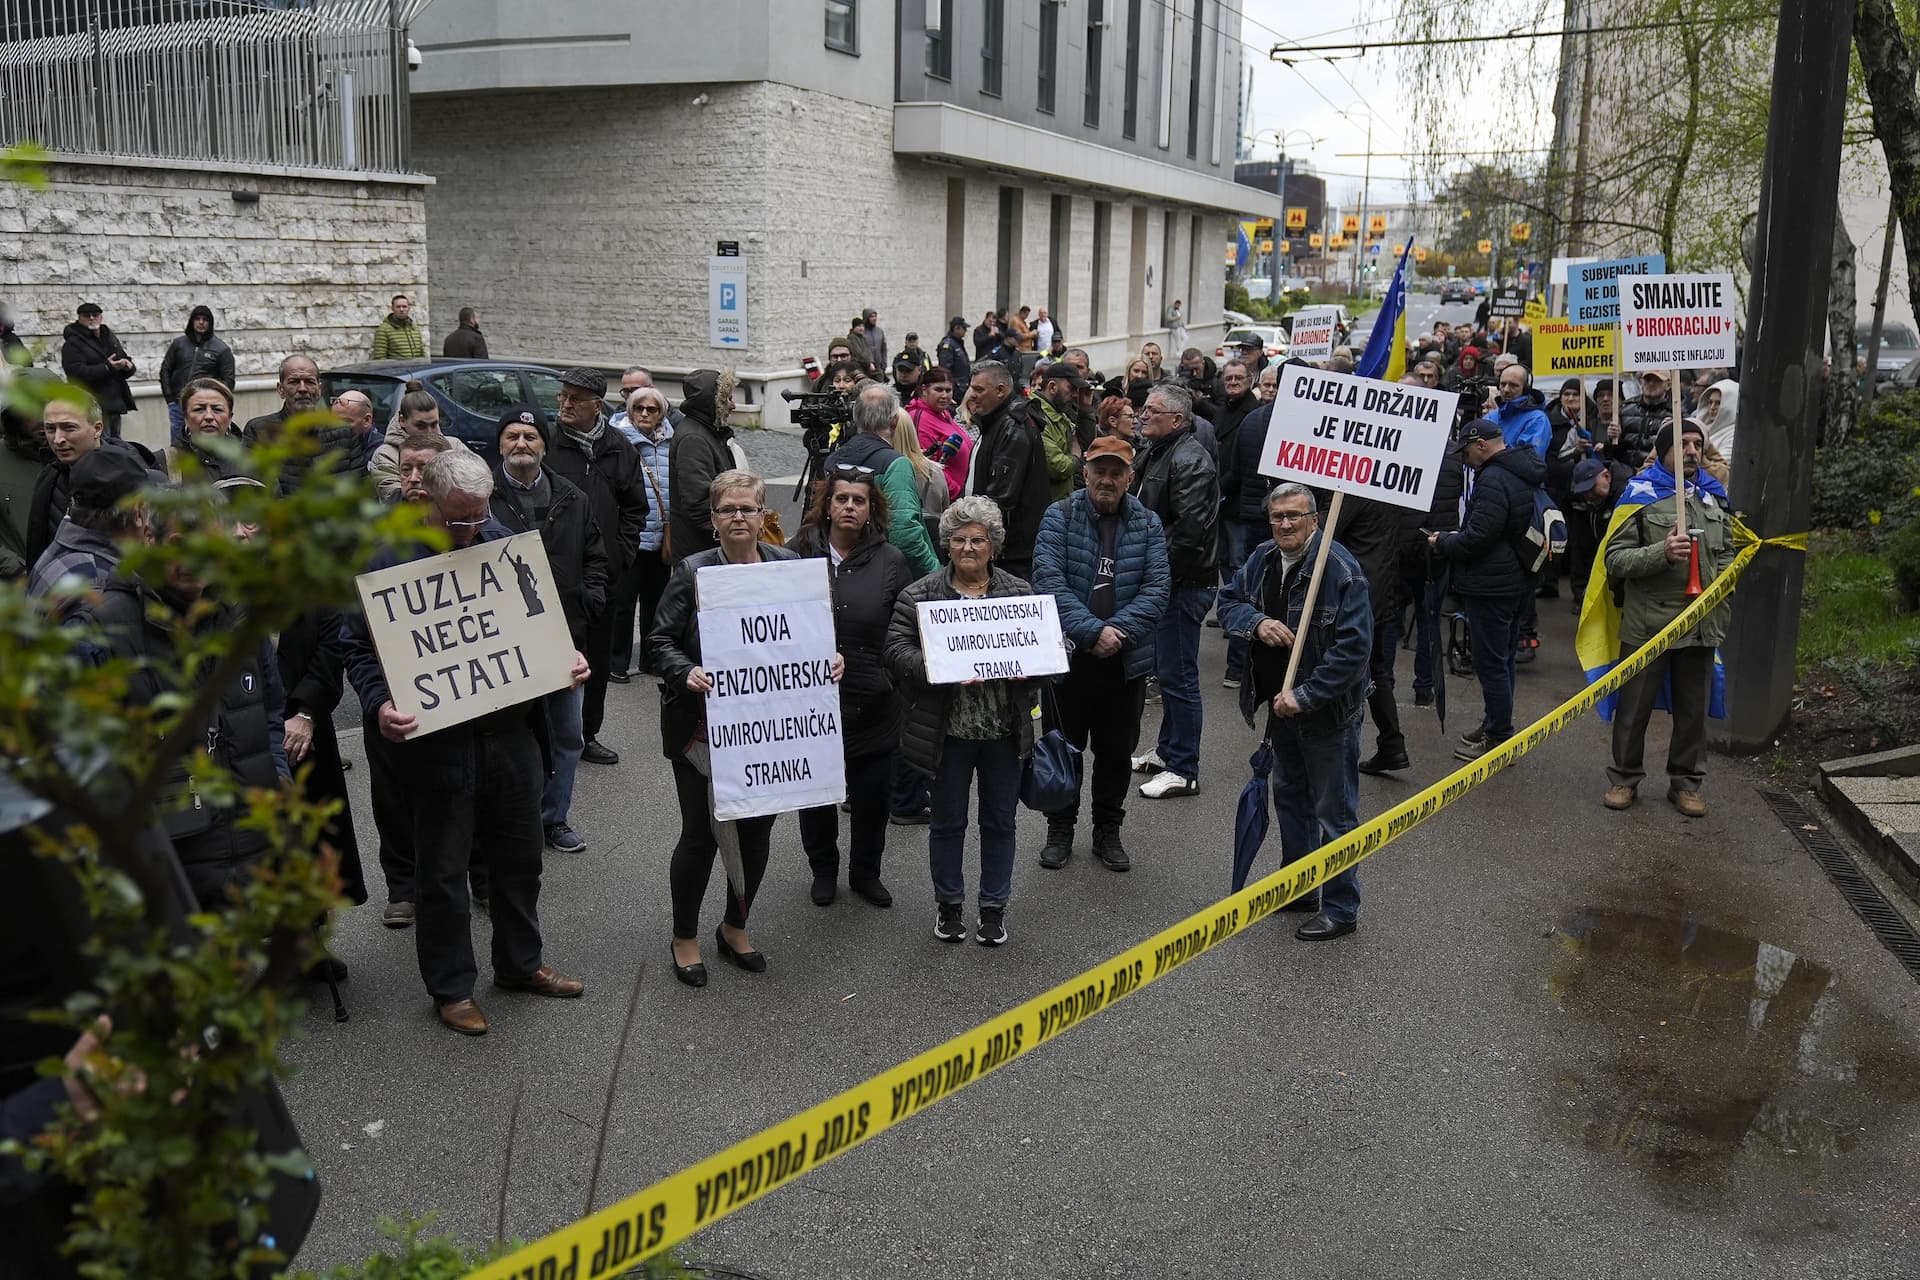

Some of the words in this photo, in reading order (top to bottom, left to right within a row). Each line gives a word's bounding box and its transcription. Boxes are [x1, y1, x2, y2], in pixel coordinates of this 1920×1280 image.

[1582, 262, 1649, 281] SUBVENCIJE
[1585, 287, 1599, 300] NE
[1602, 284, 1620, 299] DO
[1632, 282, 1722, 310] SMANJITE
[1293, 329, 1331, 346] KLADIONICE
[1539, 322, 1585, 335] PRODAJTE
[1562, 335, 1605, 350] KUPITE
[1636, 315, 1721, 337] BIROKRACIJU
[1634, 350, 1671, 364] SMANJILI
[1672, 349, 1686, 362] STE
[1687, 348, 1725, 361] INFLACIJU
[1293, 376, 1357, 408] CIJELA
[1362, 387, 1439, 422] DRŽAVA
[1313, 415, 1339, 440] JE
[1342, 419, 1402, 452] VELIKI
[1275, 440, 1423, 496] KAMENOLOM
[371, 562, 504, 623] TUZLA
[410, 606, 500, 658] NEĆE
[740, 613, 792, 645] NOVA
[930, 607, 962, 624] NOVA
[947, 627, 1039, 652] UMIROVLJENIČKA
[414, 645, 530, 710] STATI
[705, 659, 835, 699] PENZIONERSKA
[973, 660, 1023, 678] STRANKA
[711, 708, 837, 749] UMIROVLJENIČKA
[745, 757, 812, 787] STRANKA
[1207, 907, 1239, 948] STOP
[1154, 923, 1208, 978] POLICIJA
[1106, 958, 1144, 1005] STOP
[1037, 979, 1106, 1042] POLICIJA
[978, 1022, 1025, 1079] STOP
[889, 1045, 976, 1122] POLICIJA
[813, 1101, 872, 1163] STOP
[695, 1132, 807, 1226] POLICIJA
[589, 1203, 667, 1279] STOP
